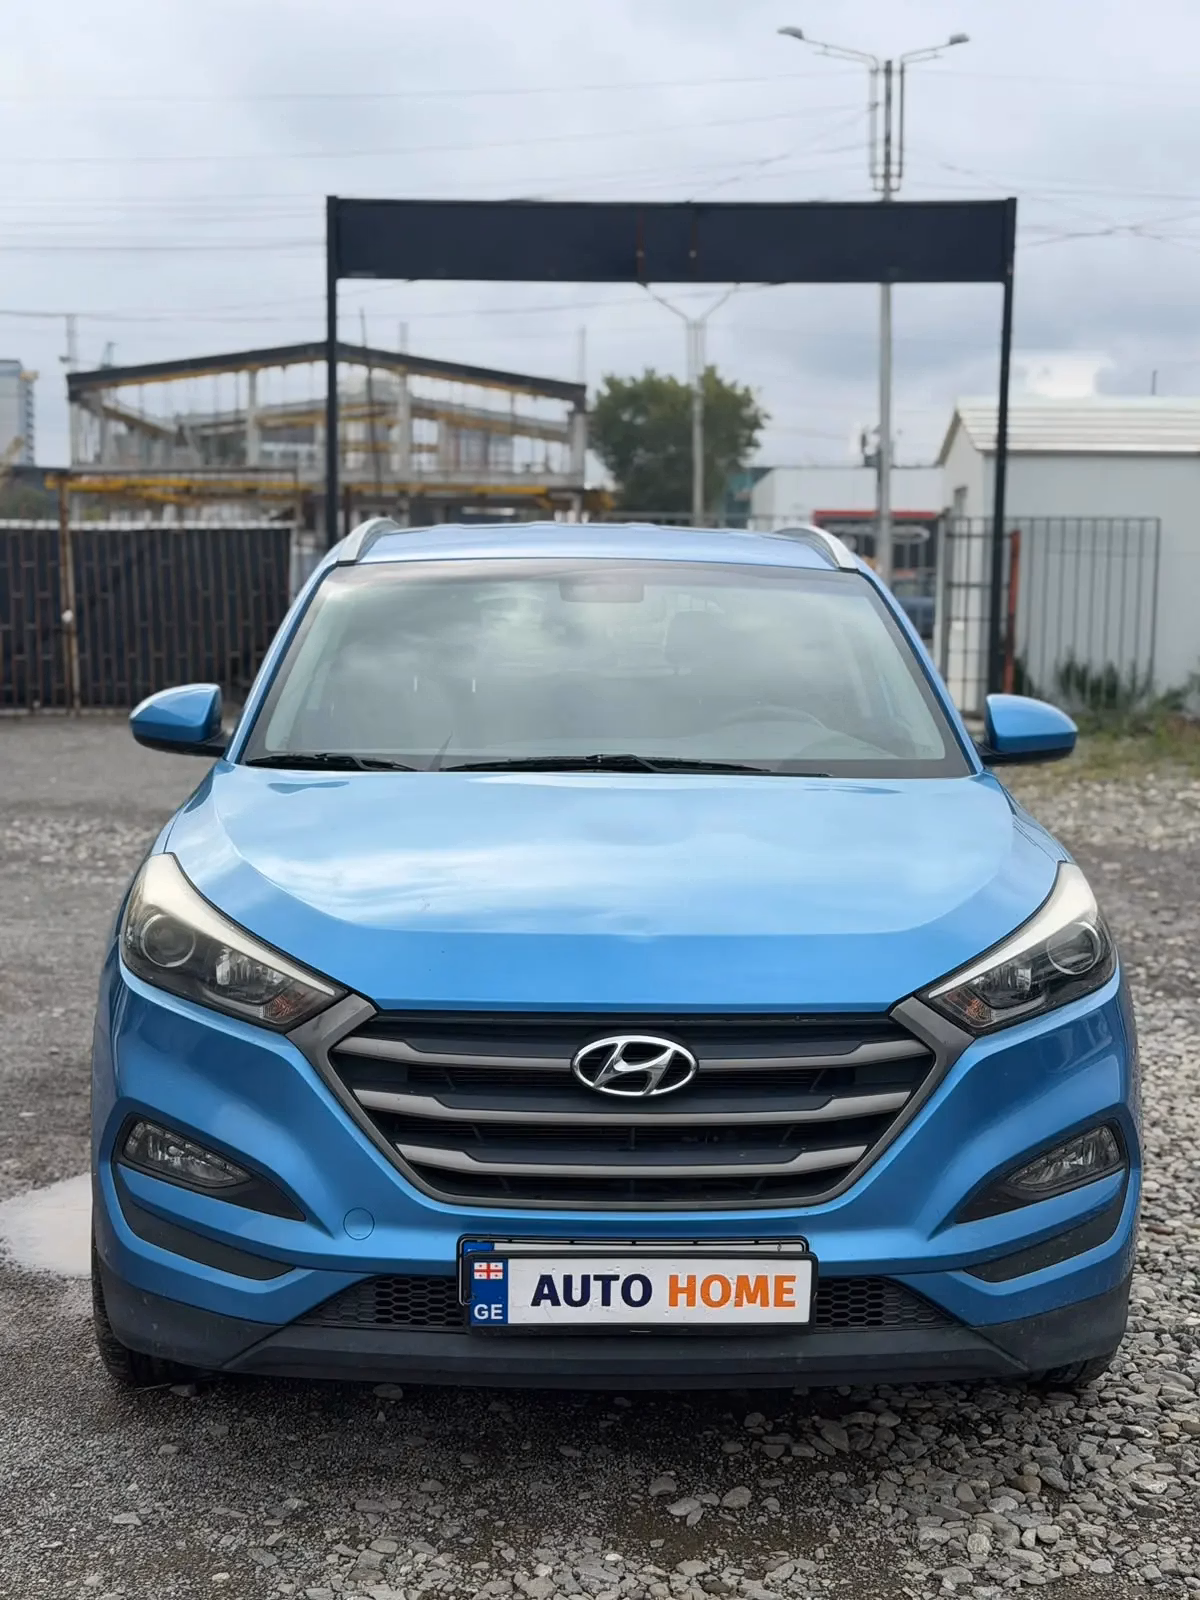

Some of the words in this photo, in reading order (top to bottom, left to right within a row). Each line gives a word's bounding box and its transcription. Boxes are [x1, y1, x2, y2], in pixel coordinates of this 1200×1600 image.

[531, 1274, 652, 1307] AUTO
[668, 1274, 796, 1307] HOME
[474, 1304, 503, 1319] GE
